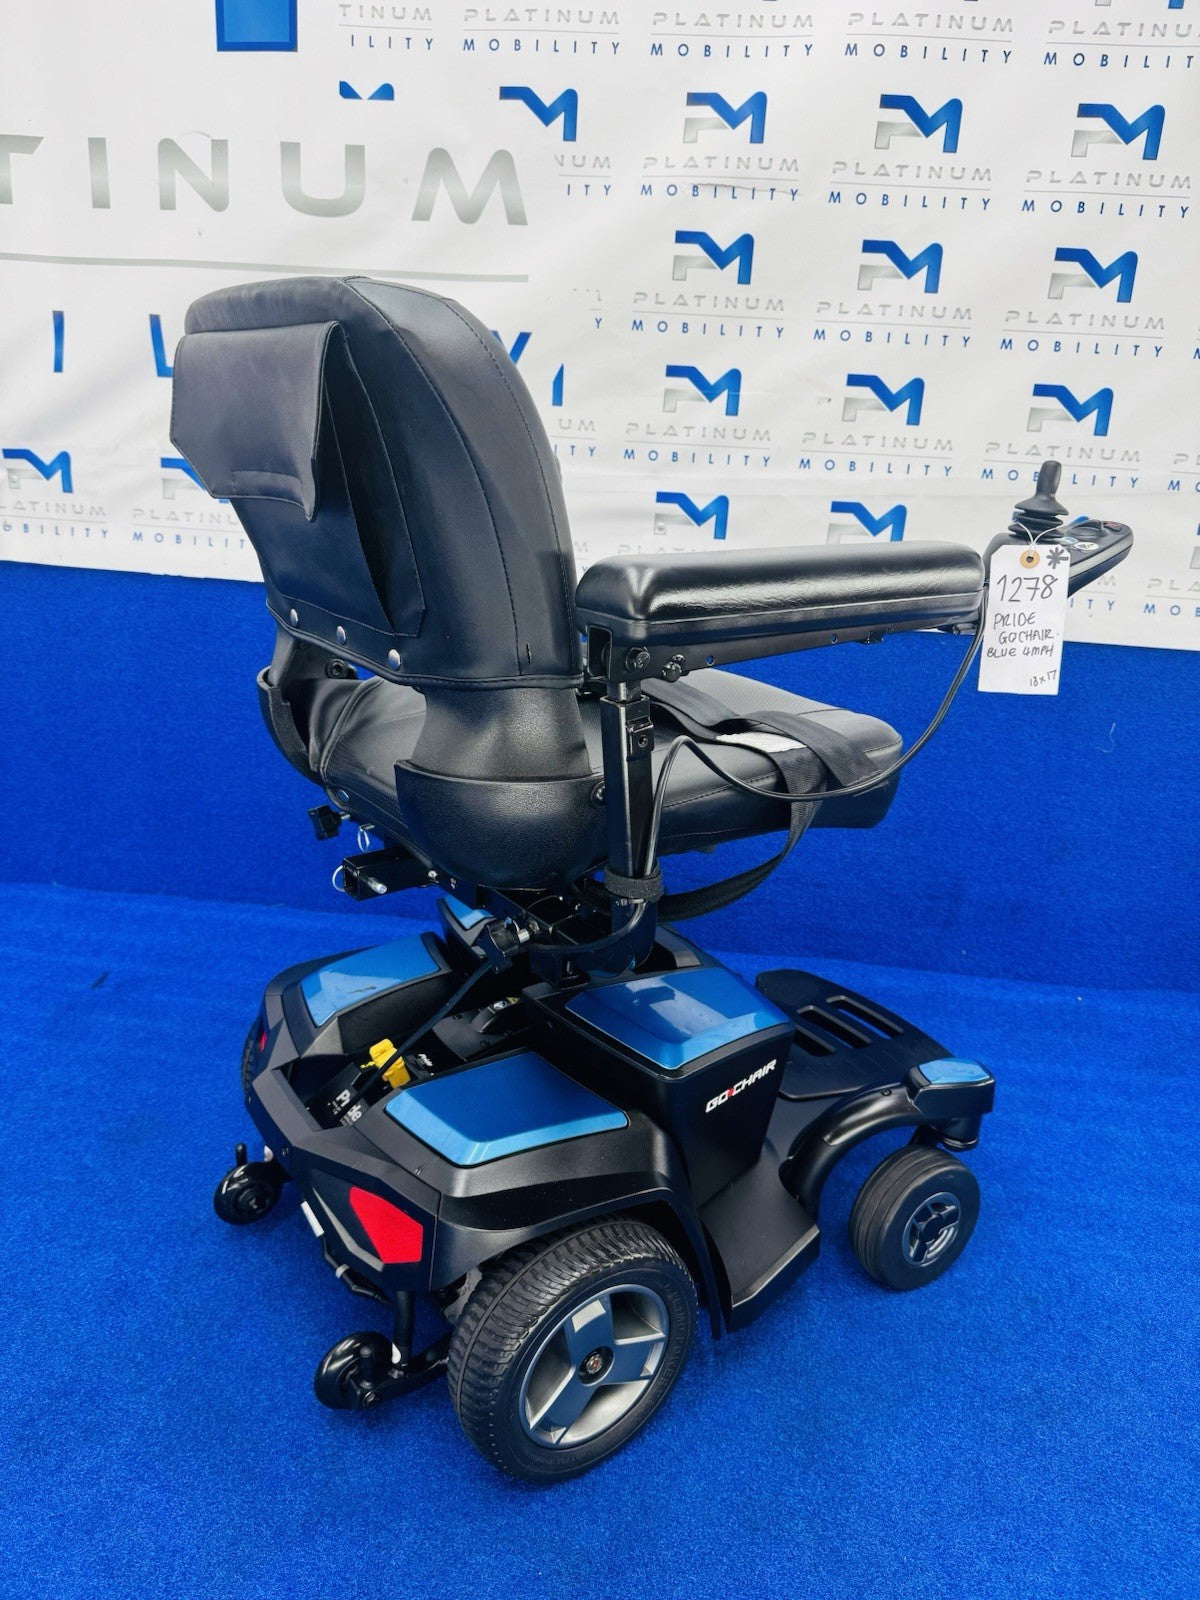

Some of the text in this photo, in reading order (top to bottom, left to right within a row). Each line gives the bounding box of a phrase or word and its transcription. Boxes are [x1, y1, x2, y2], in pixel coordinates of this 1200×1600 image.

[339, 4, 433, 22] TINUM
[463, 8, 620, 25] PLATINUM
[652, 12, 814, 29] PLATINUM
[848, 13, 1014, 33] PLATINUM
[1048, 20, 1200, 38] PLATINU
[350, 34, 433, 51] ILITY
[463, 38, 620, 56] MOBILITY
[650, 43, 813, 59] MOBILITY
[844, 43, 1012, 65] MOBILITY
[1044, 52, 1194, 68] MOBILIT
[643, 156, 799, 173] PLATINUM
[832, 160, 992, 182] PLATINUM
[567, 183, 612, 196] ITY
[1026, 169, 1191, 190] PLATINUM
[640, 183, 799, 202] MOBILITY
[829, 190, 991, 211] MOBILITY
[1022, 200, 1189, 219] MOBILITY
[633, 291, 785, 312] PLATINUM
[816, 300, 973, 321] PLATINUM
[632, 319, 784, 339] MOBILITY
[1004, 309, 1165, 330] PLATINUM
[813, 328, 971, 348] MOBILITY
[1000, 338, 1163, 358] MOBILITY
[625, 422, 771, 442] PLATINUM
[802, 432, 954, 452] PLATINUM
[624, 449, 770, 467] MOBILITY
[986, 441, 1141, 462] PLATINUM
[799, 457, 953, 477] MOBILITY
[981, 468, 1139, 488] MOBLITY
[997, 574, 1058, 602] 1278
[994, 611, 1036, 630] PRIDE
[987, 645, 1054, 658] BLUE 4MPH
